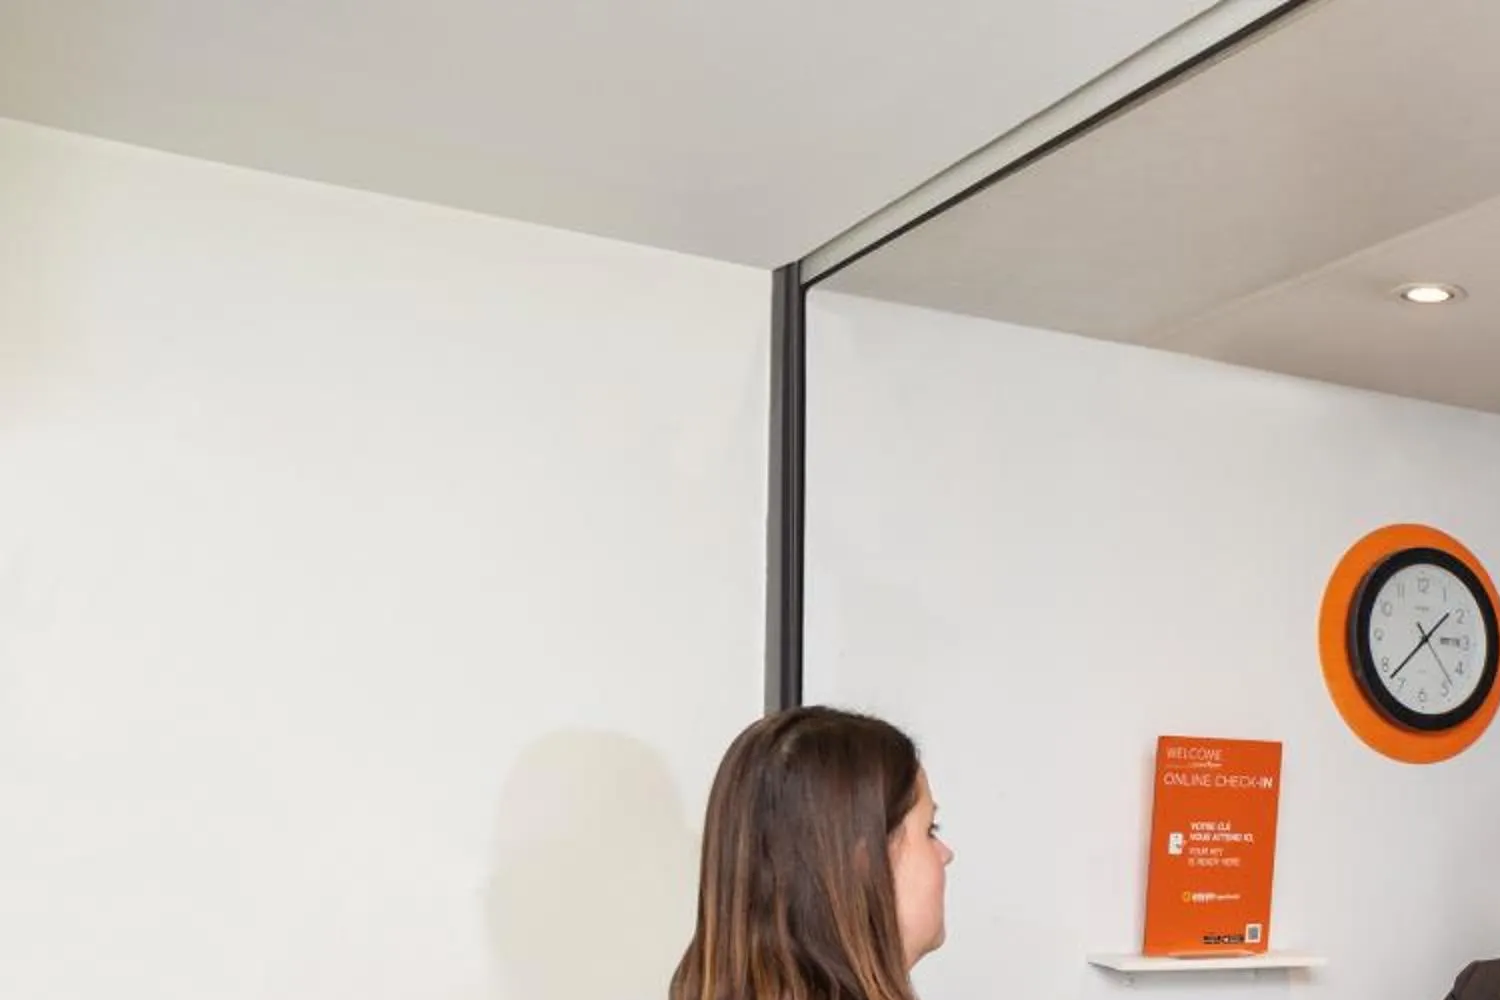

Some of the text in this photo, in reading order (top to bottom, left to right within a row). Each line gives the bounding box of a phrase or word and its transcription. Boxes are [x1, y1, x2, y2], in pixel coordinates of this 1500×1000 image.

[1417, 577, 1430, 594] 12
[1454, 608, 1465, 625] 2
[1381, 655, 1390, 673] 8
[1454, 660, 1465, 676] 4
[1417, 688, 1427, 703] 6
[1166, 746, 1222, 761] WELCOME
[1163, 771, 1273, 789] ONLINE CHECK-IN
